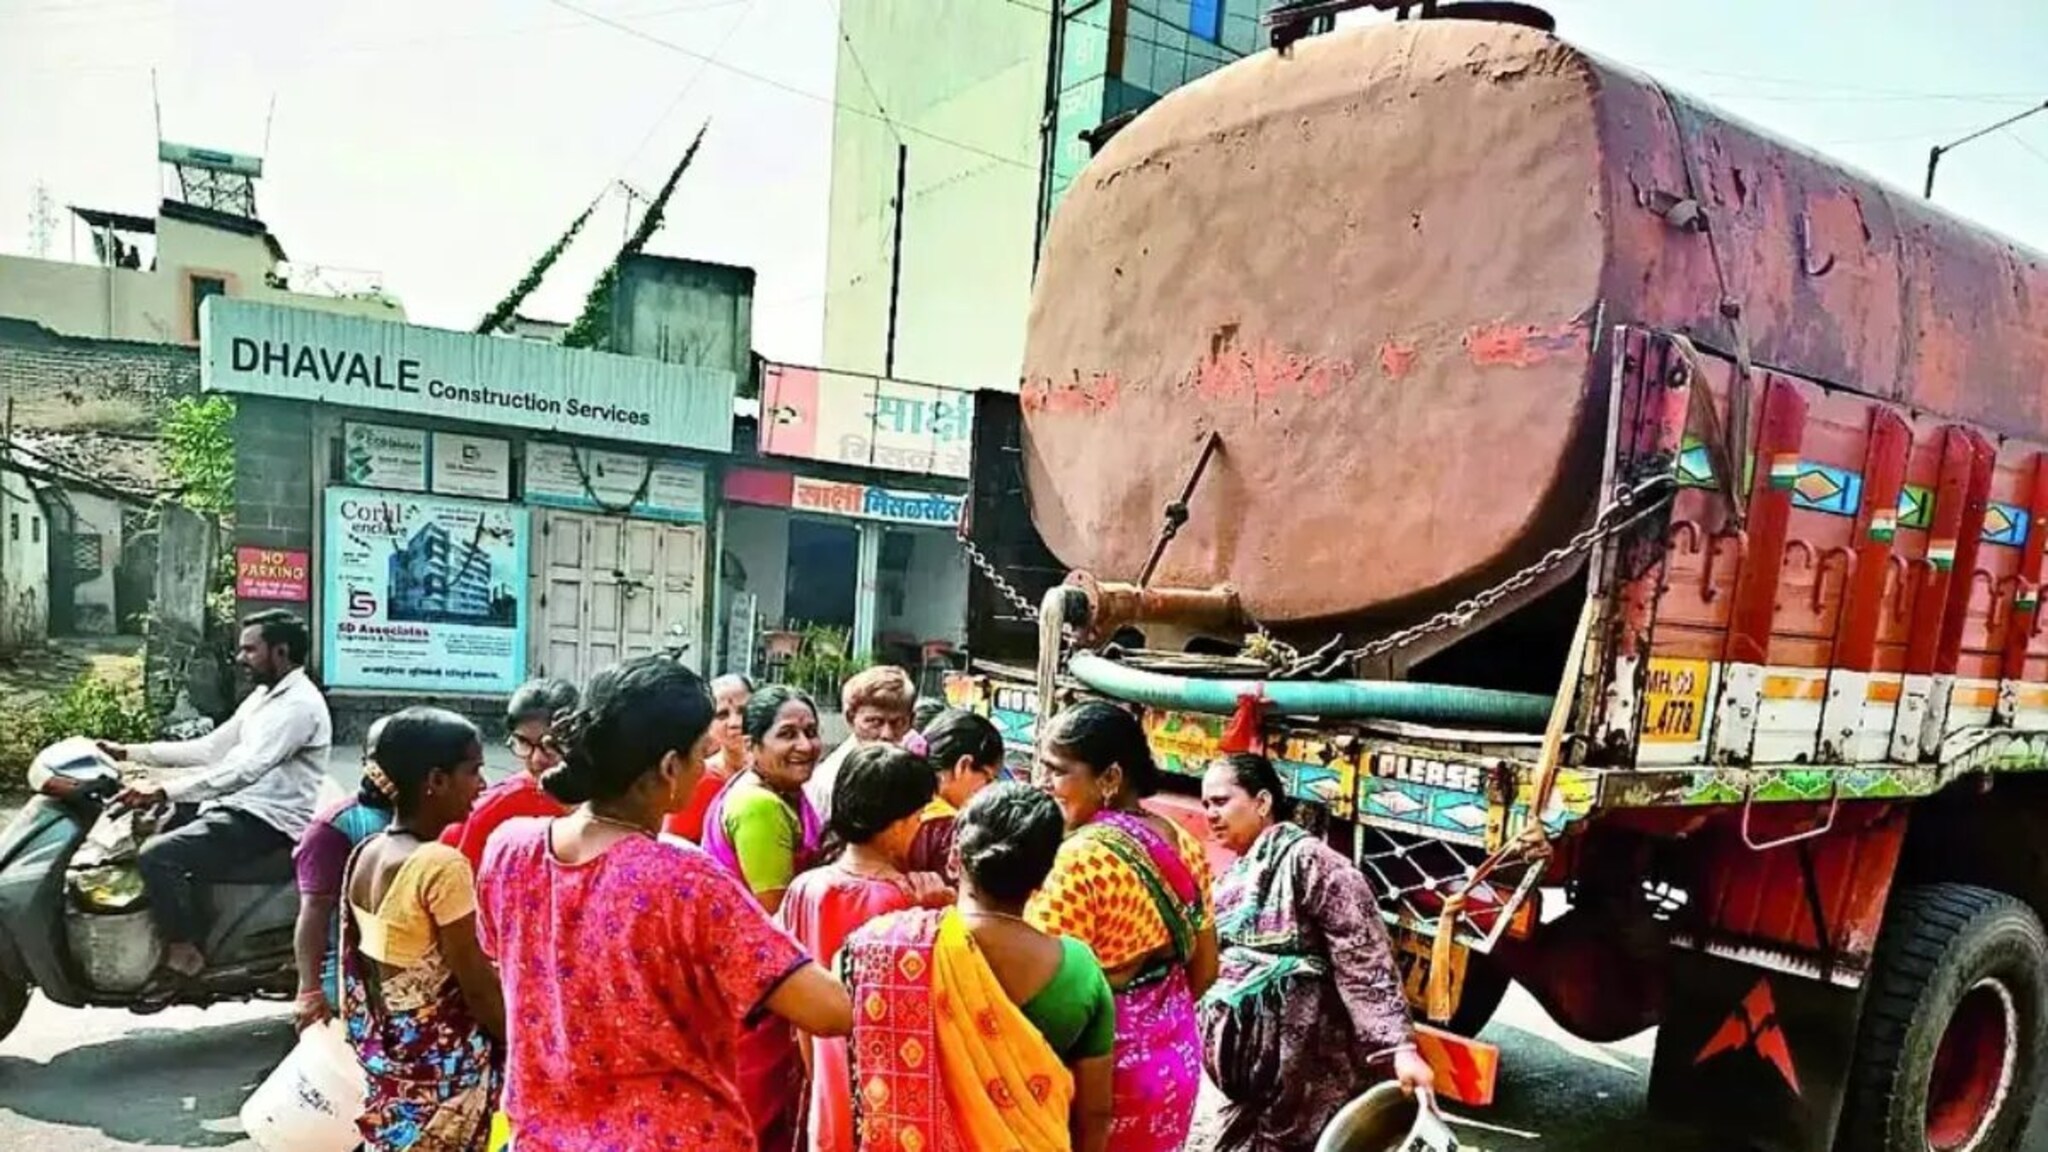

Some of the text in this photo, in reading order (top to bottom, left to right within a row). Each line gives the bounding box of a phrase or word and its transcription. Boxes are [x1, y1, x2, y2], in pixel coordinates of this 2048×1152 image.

[232, 337, 650, 425] DHAVALE Construction Services
[260, 551, 285, 565] NO
[239, 562, 304, 581] PARKING
[358, 624, 430, 637] Associates
[1378, 753, 1481, 794] PLEASE
